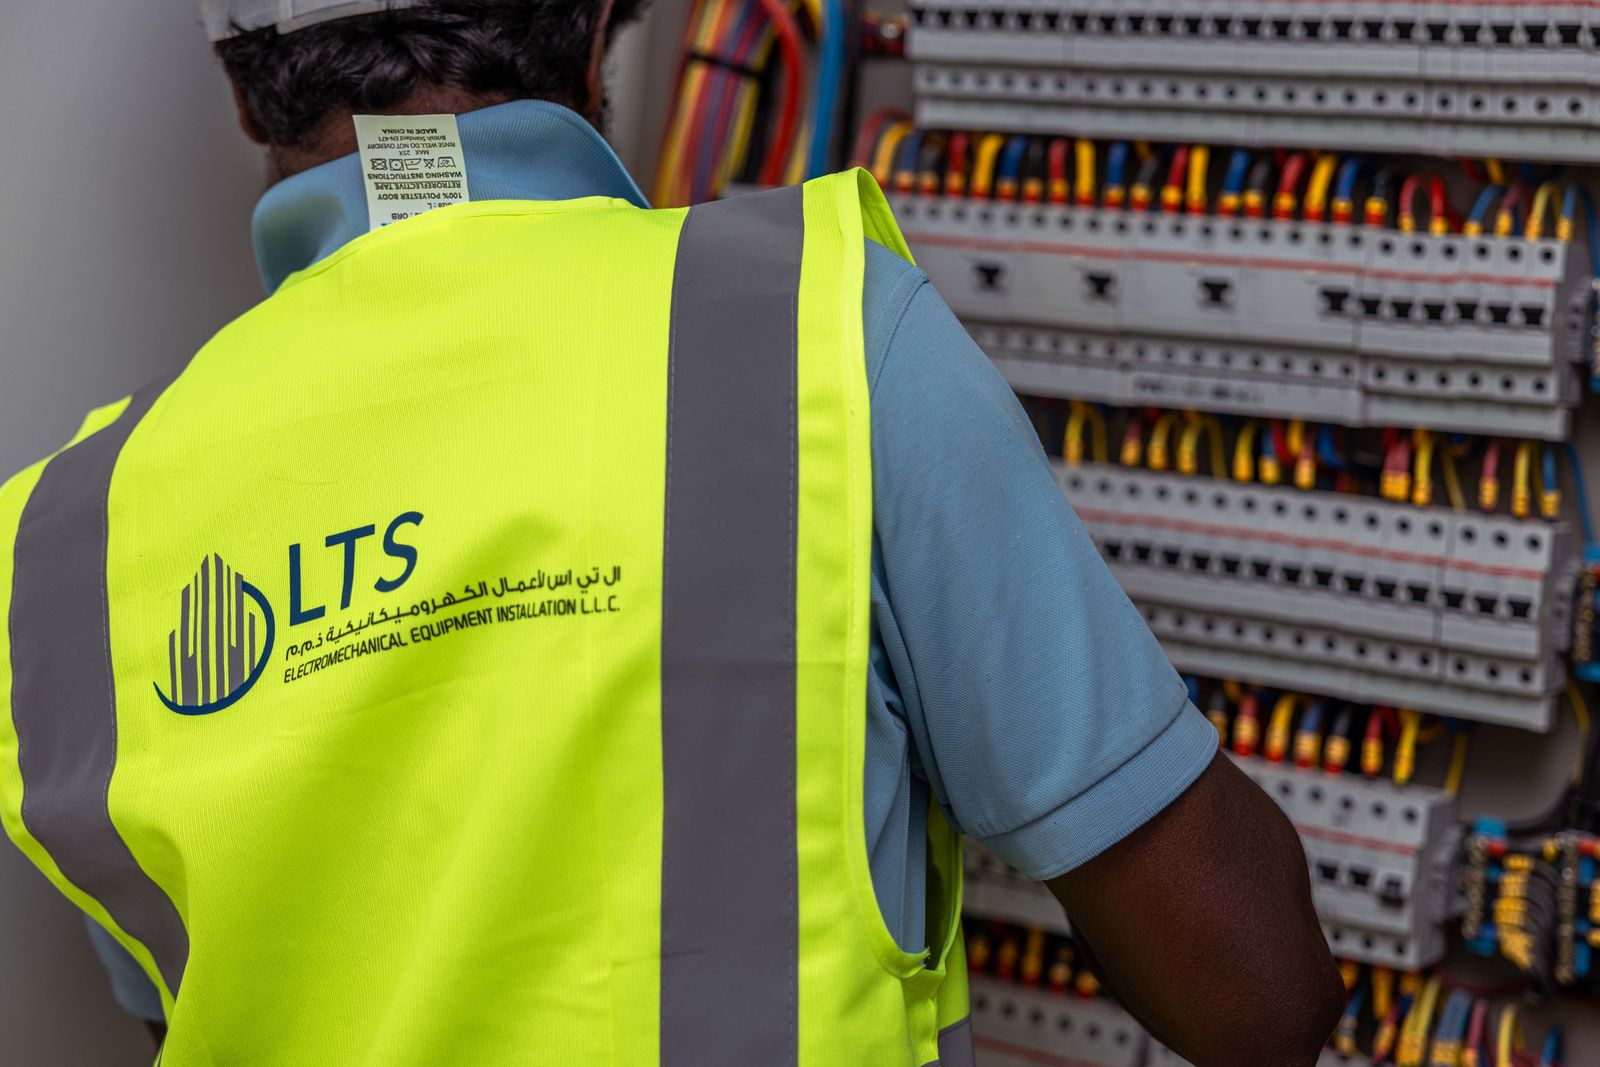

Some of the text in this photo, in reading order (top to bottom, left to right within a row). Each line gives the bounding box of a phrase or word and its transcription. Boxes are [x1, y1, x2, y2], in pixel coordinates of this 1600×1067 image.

[288, 511, 424, 626] LTS
[283, 595, 621, 684] ELECTROMECHANICAL EQUIPMENT INSTALLATION L.L.C.
